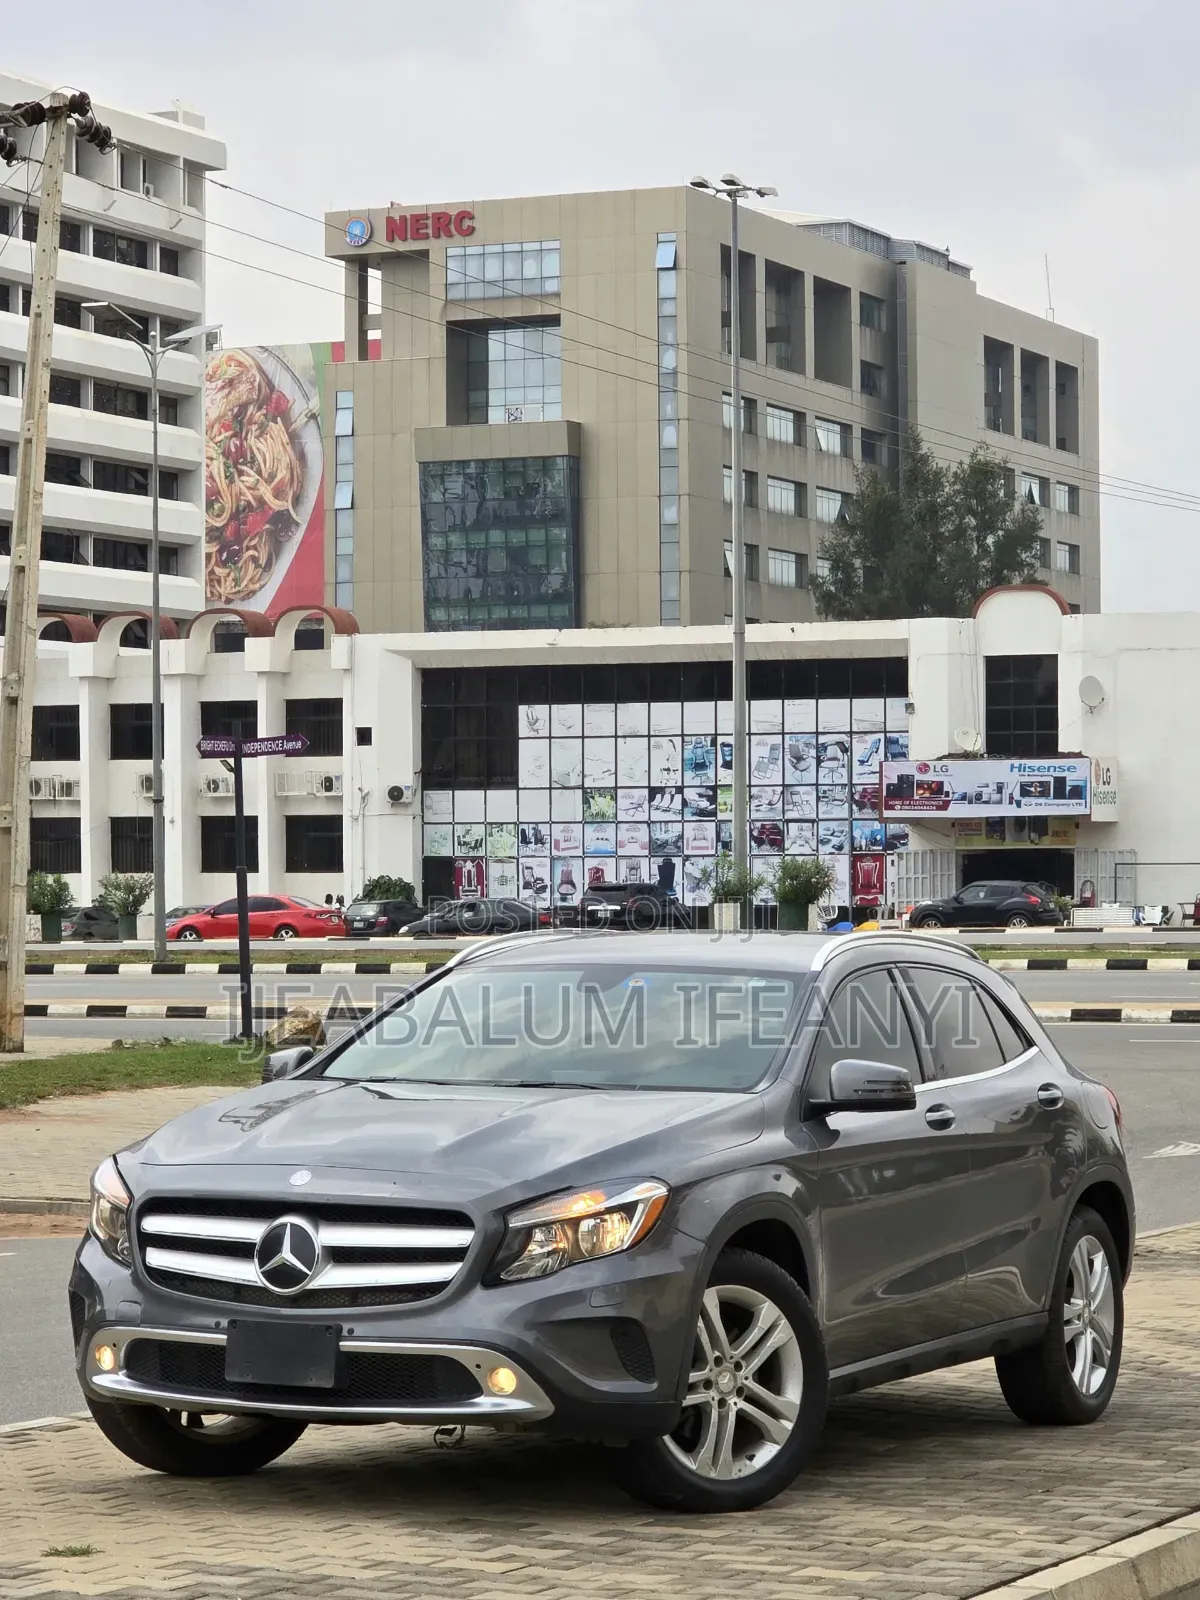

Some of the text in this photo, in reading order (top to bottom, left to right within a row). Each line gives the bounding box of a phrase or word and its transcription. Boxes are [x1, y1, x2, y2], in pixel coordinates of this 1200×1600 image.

[385, 210, 475, 242] NERC
[200, 740, 214, 751] BRIGHT
[242, 740, 302, 754] INDEPENDENCE Avenue
[933, 764, 949, 773] LG
[1009, 763, 1077, 773] Hisense
[1102, 767, 1111, 786] LG
[1092, 786, 1117, 805] Hisense
